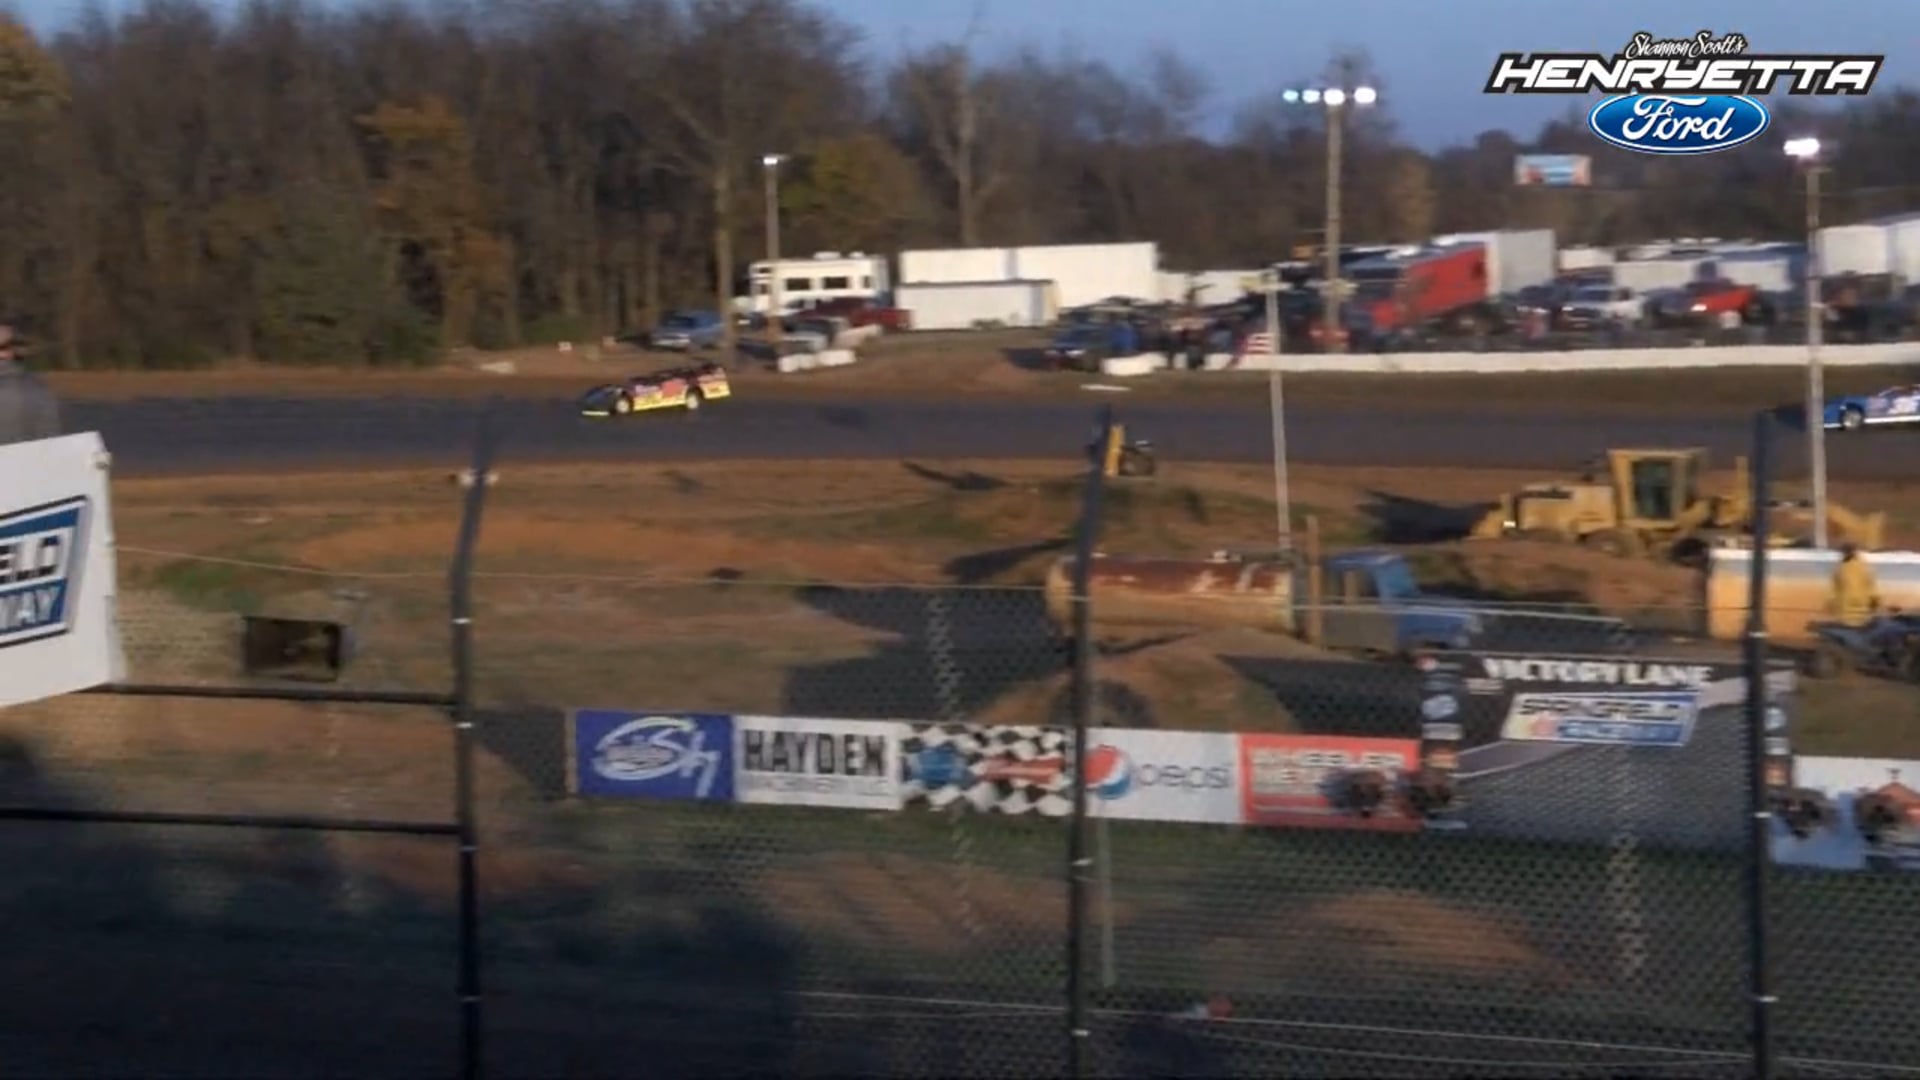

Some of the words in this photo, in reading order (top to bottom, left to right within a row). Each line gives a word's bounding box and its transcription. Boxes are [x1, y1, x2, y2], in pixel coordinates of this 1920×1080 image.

[1483, 657, 1623, 684] VICTORY
[1625, 663, 1713, 689] LANE
[744, 728, 887, 776] HAYDEN
